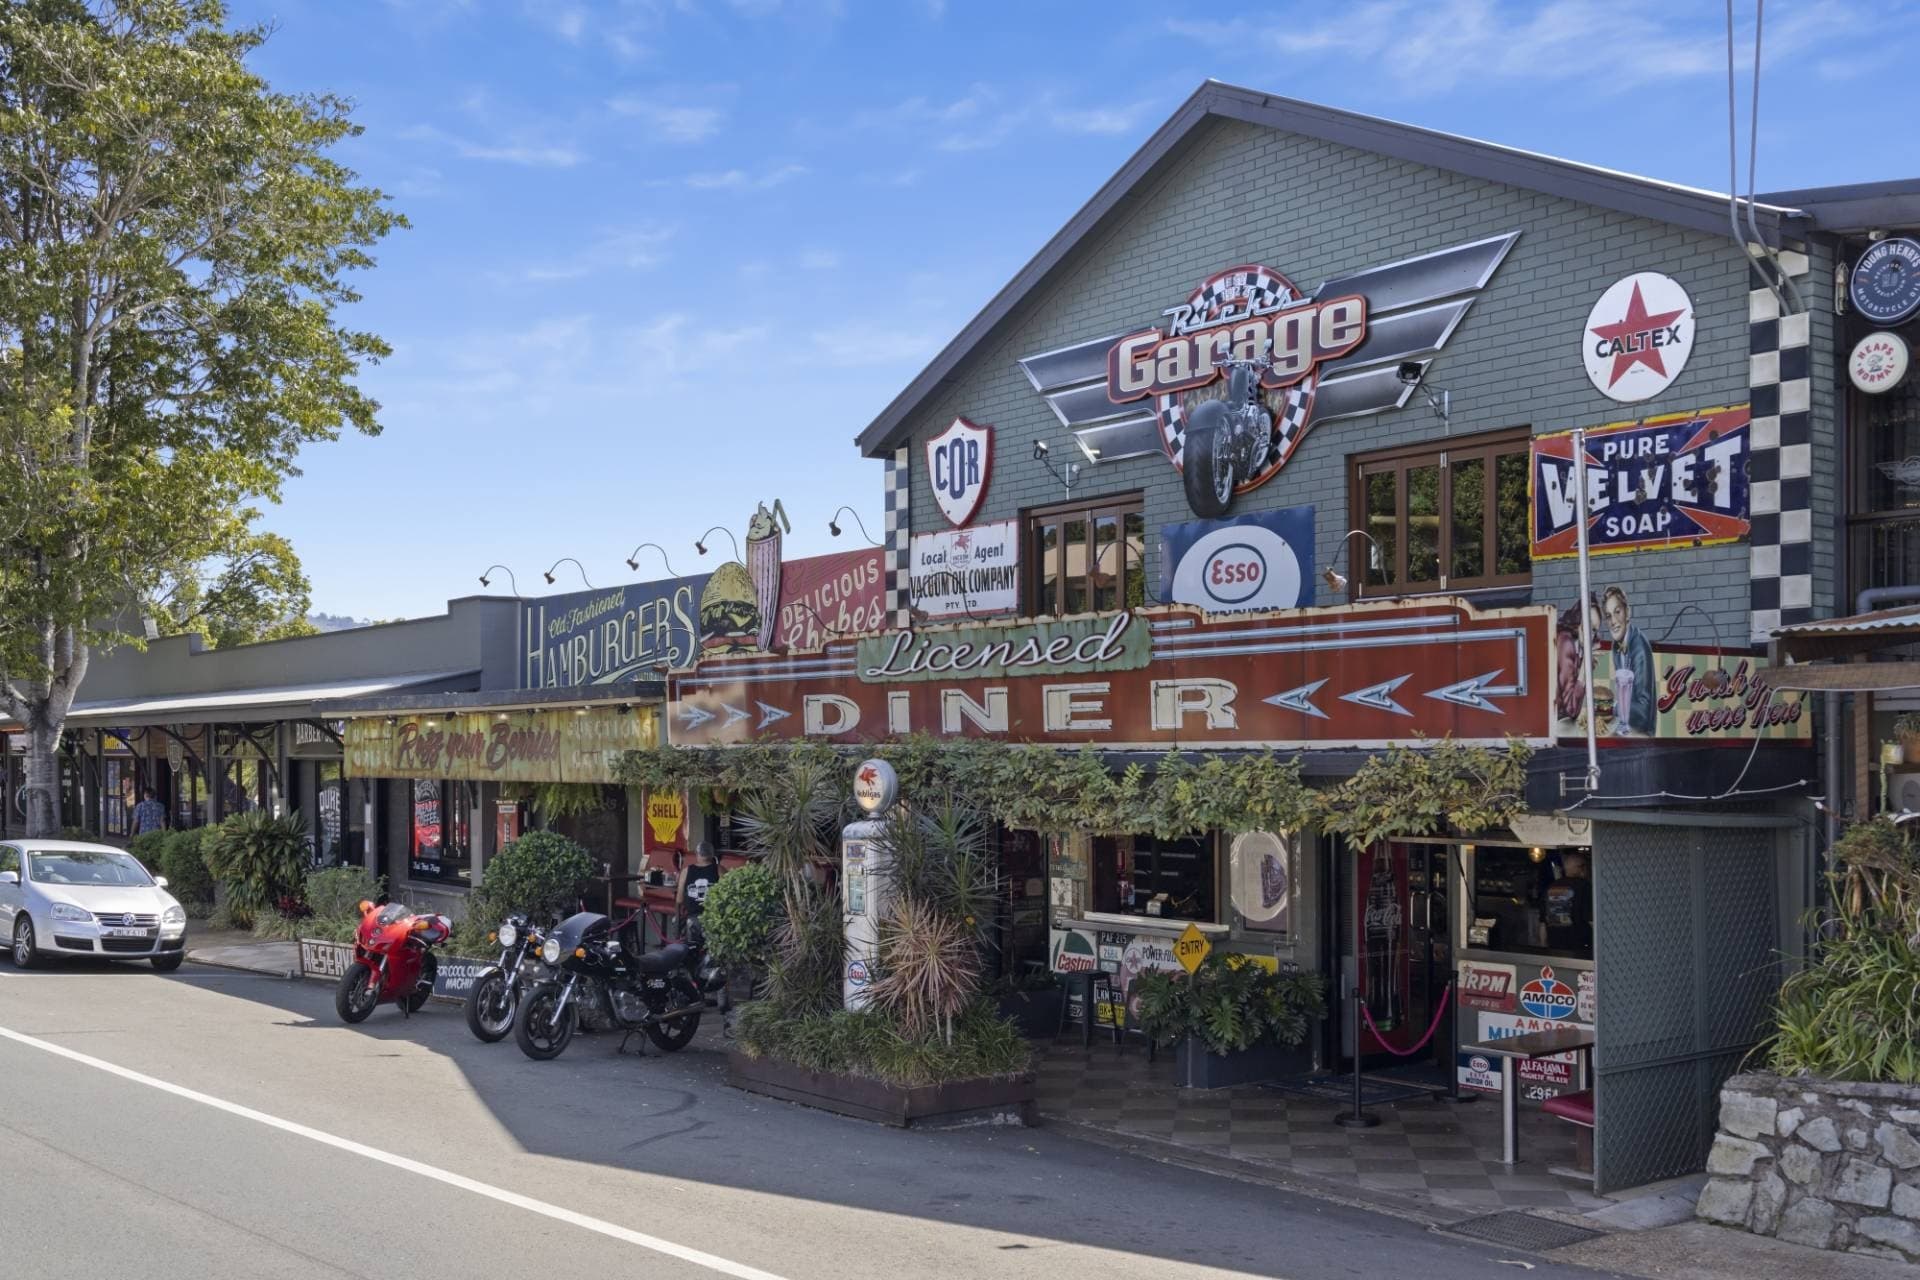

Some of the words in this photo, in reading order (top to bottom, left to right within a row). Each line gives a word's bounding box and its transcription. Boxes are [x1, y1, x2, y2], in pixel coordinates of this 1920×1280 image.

[1858, 246, 1888, 273] YOUNG
[1857, 288, 1909, 313] MOTORCYCLE
[1118, 299, 1363, 393] Garage
[1595, 324, 1682, 358] CALTEX
[1858, 342, 1894, 360] HEAPS
[1856, 363, 1895, 383] NORMAL
[1603, 434, 1670, 462] PURE
[1541, 435, 1742, 529] VELVET
[1606, 512, 1672, 537] SOAP
[921, 551, 947, 566] Local
[974, 543, 1004, 563] Agent
[910, 570, 950, 600] VACUUM
[952, 570, 968, 595] OIL
[968, 565, 1017, 594] COMPANY
[1211, 559, 1260, 586] Esso
[782, 558, 879, 630] DELICIOUS
[527, 584, 697, 690] HAMBURGERS
[865, 612, 1131, 678] Licensed
[803, 678, 1239, 736] DINER
[1687, 706, 1746, 734] were
[296, 722, 321, 745] BARBER
[652, 803, 679, 819] SHELL
[1180, 940, 1205, 956] ENTRY
[1057, 953, 1096, 973] Castrol
[1467, 973, 1506, 993] RPM
[1522, 992, 1576, 1006] AMOCO
[1472, 1061, 1488, 1070] Esso
[1520, 1060, 1568, 1076] ALFA-LAVAL
[1484, 1079, 1494, 1088] OIL
